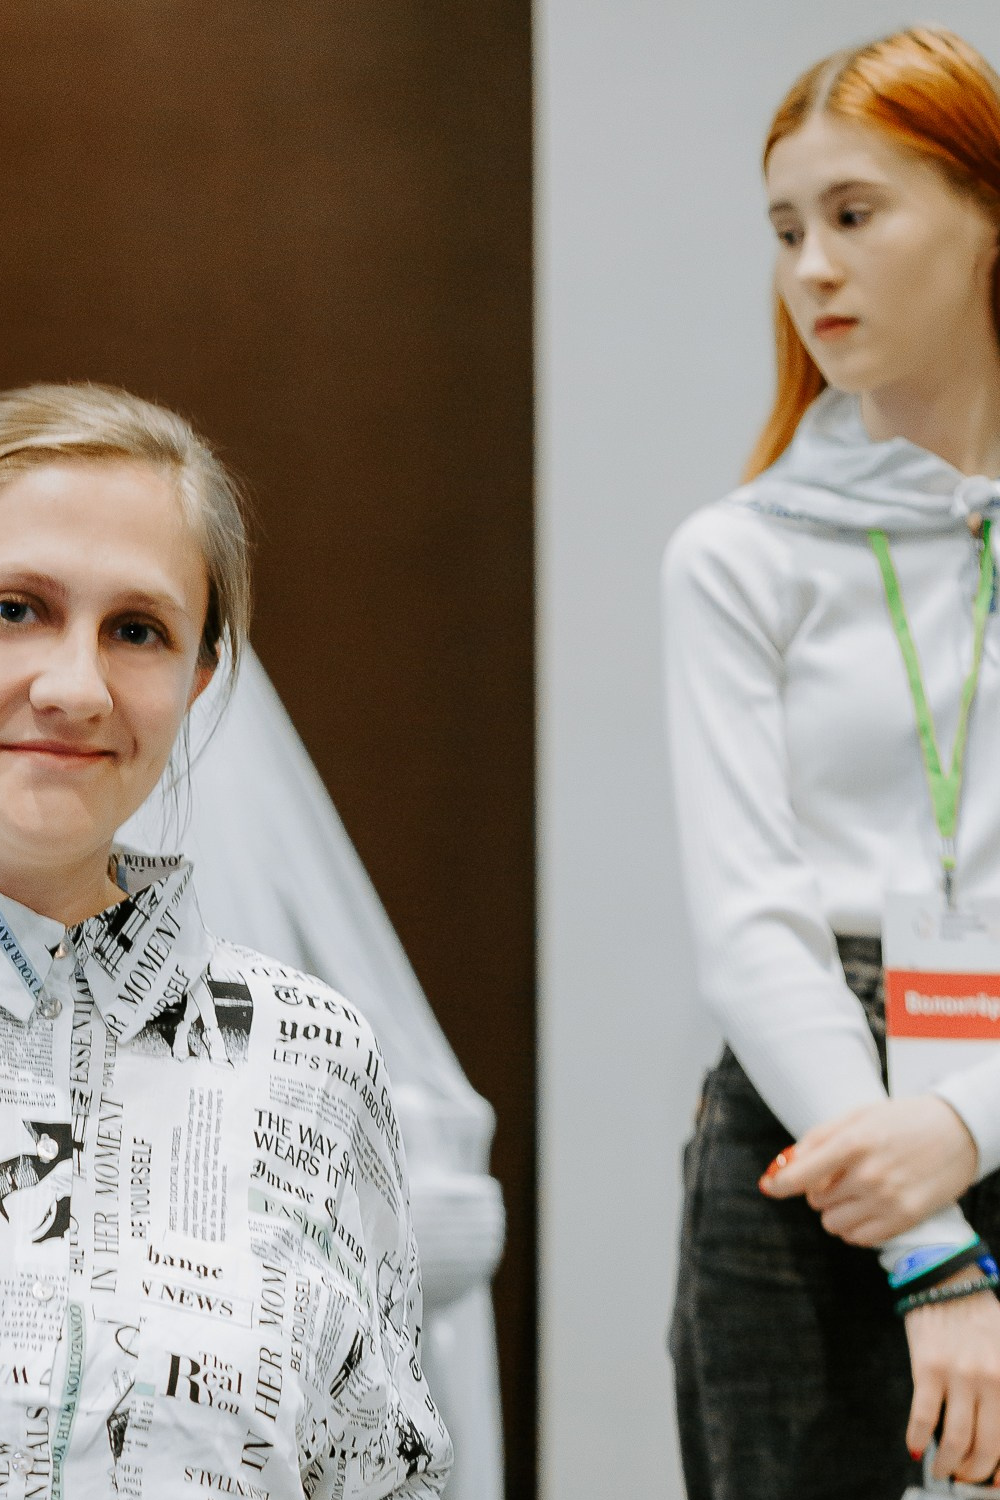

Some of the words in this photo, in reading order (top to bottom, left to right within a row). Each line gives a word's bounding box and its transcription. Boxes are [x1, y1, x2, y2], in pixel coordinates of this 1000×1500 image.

[10, 949, 38, 988] YOUR
[117, 908, 182, 1009] MOMENT
[273, 1048, 321, 1072] LET'S
[325, 1057, 362, 1091] TALK
[95, 1091, 124, 1199] MOMENT
[253, 1130, 321, 1178] WEARS
[254, 1107, 293, 1140] THE
[298, 1122, 338, 1160] WAY
[93, 1211, 120, 1255] HER
[90, 1265, 118, 1294] IN
[145, 1244, 225, 1280] hange
[197, 1350, 233, 1372] The
[201, 1394, 241, 1416] You
[253, 1347, 284, 1423] HER
[240, 1429, 275, 1473] IN
